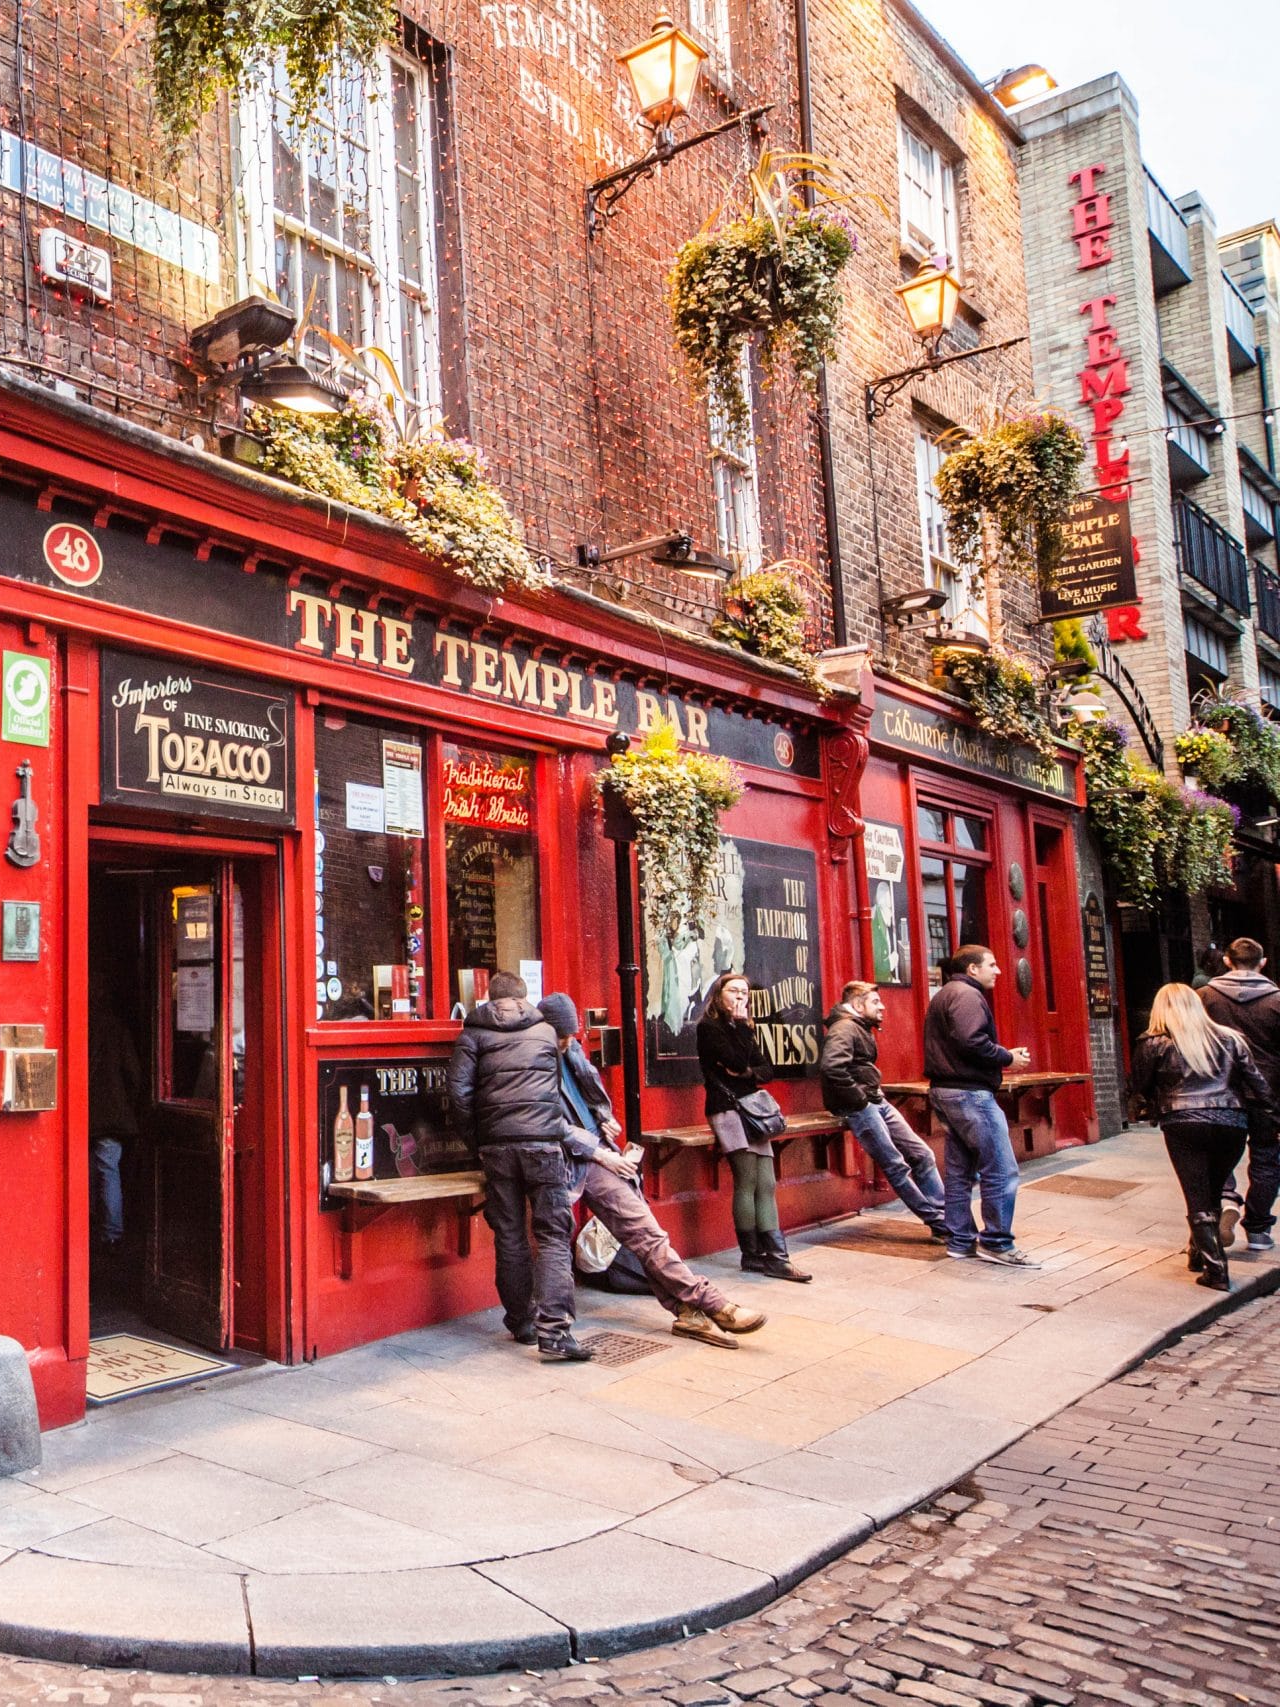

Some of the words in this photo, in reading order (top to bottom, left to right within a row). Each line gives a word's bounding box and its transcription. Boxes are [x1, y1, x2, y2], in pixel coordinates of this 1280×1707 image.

[26, 173, 84, 213] TEMPLE
[89, 204, 130, 234] LANE
[1068, 163, 1113, 271] THE
[1077, 293, 1133, 502] TEMPLE
[54, 532, 90, 572] 48
[1053, 565, 1076, 577] EER
[1078, 557, 1122, 572] GARDEN
[1057, 589, 1080, 600] LIVE
[1083, 582, 1118, 596] MUSIC
[1073, 593, 1103, 606] DAILY
[290, 590, 415, 674] THE
[435, 631, 620, 725] TEMPLE
[636, 690, 710, 748] BAR
[112, 675, 192, 714] Importers
[163, 699, 178, 712] OF
[183, 711, 213, 732] FINE
[214, 718, 270, 742] SMOKING
[134, 713, 272, 784] TOBACCO
[778, 737, 790, 759] 48
[165, 775, 217, 796] Always
[225, 785, 237, 799] in
[242, 786, 281, 806] Stock
[443, 759, 524, 791] Traditional
[443, 788, 479, 818] Irish
[485, 796, 529, 826] Music
[462, 841, 500, 867] TEMPLE
[783, 878, 807, 908] THE
[756, 908, 808, 941] EMPEROR
[795, 945, 809, 973] OF
[772, 976, 815, 1013] LIQUORS
[376, 1067, 419, 1096] THE
[107, 1362, 180, 1382] BAR
